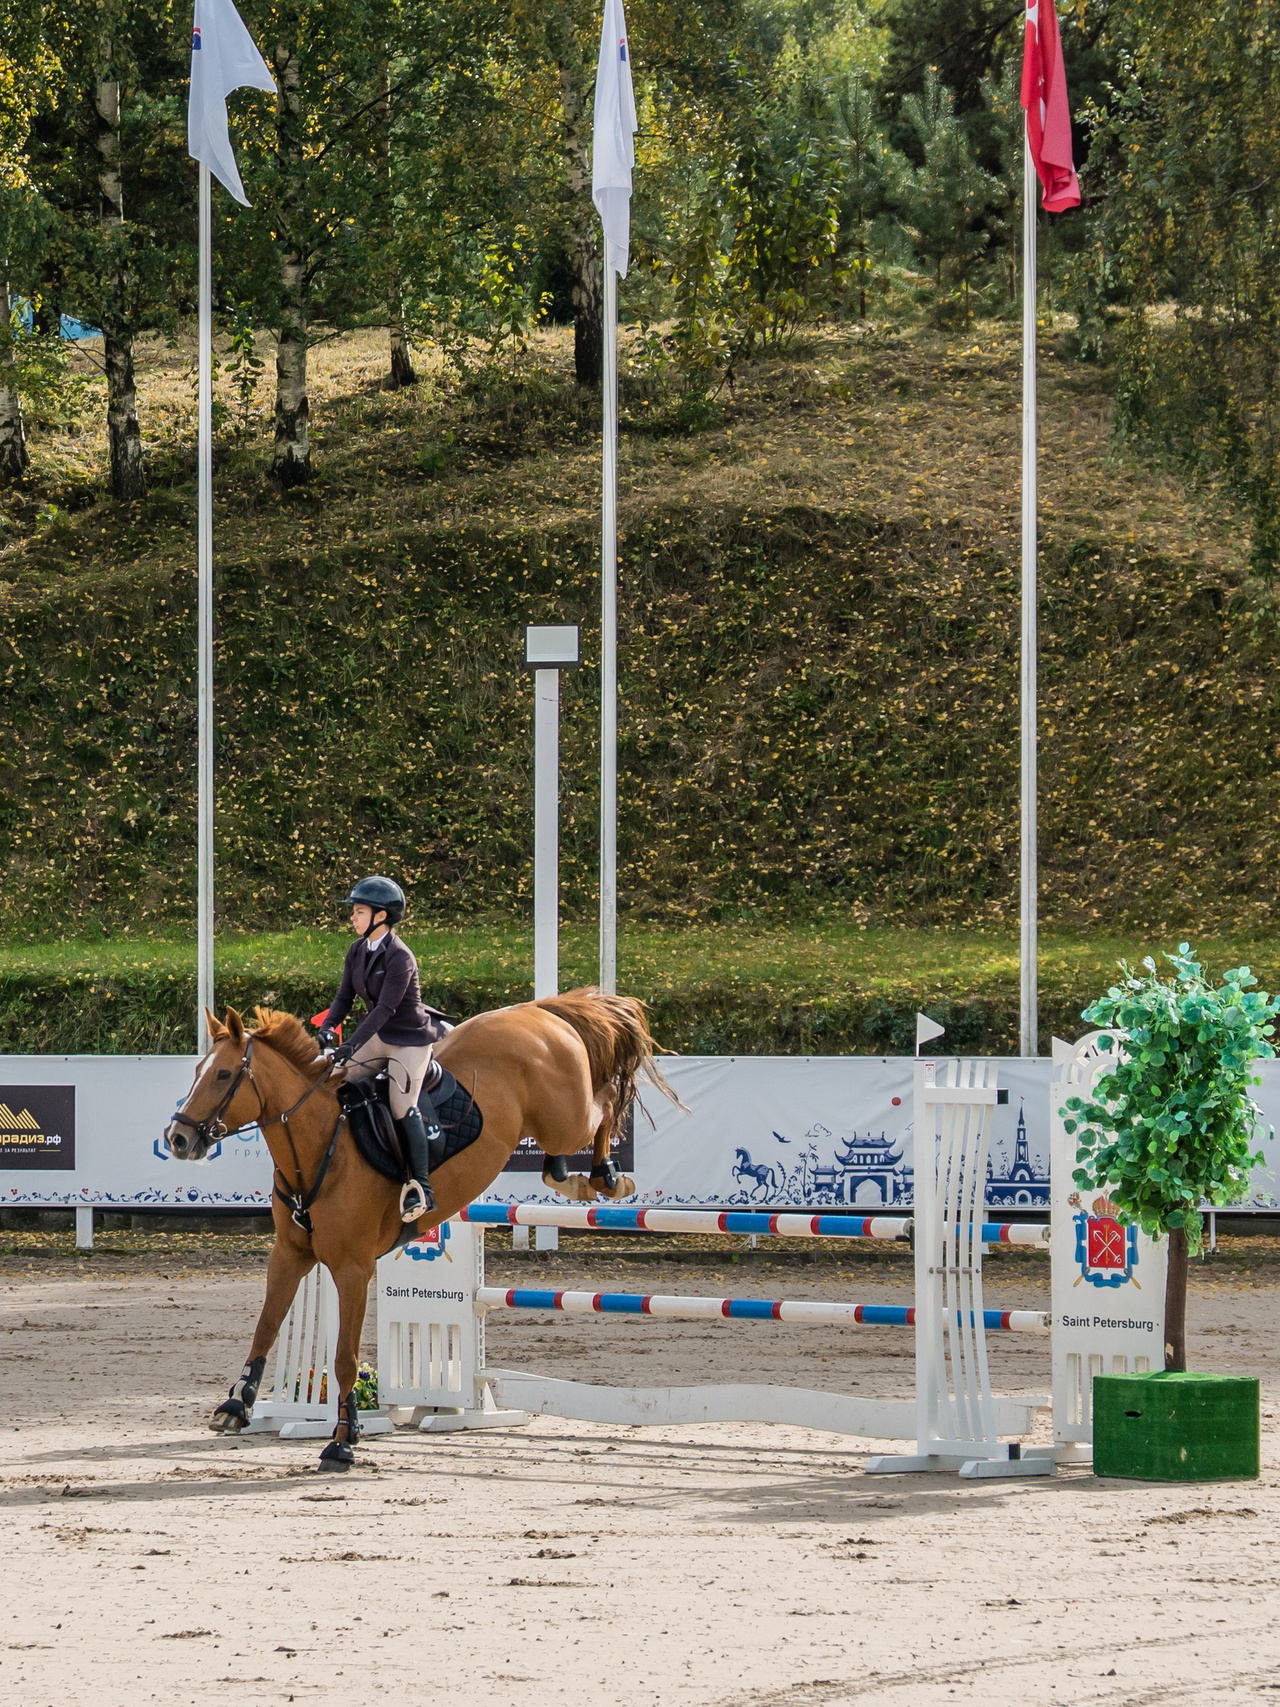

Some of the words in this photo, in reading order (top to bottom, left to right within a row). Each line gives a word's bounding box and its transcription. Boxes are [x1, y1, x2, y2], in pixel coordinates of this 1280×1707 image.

[386, 1286, 410, 1298] Saint
[412, 1287, 464, 1302] Petersburg
[1062, 1315, 1090, 1327] Saint
[1093, 1316, 1154, 1332] Petersburg
